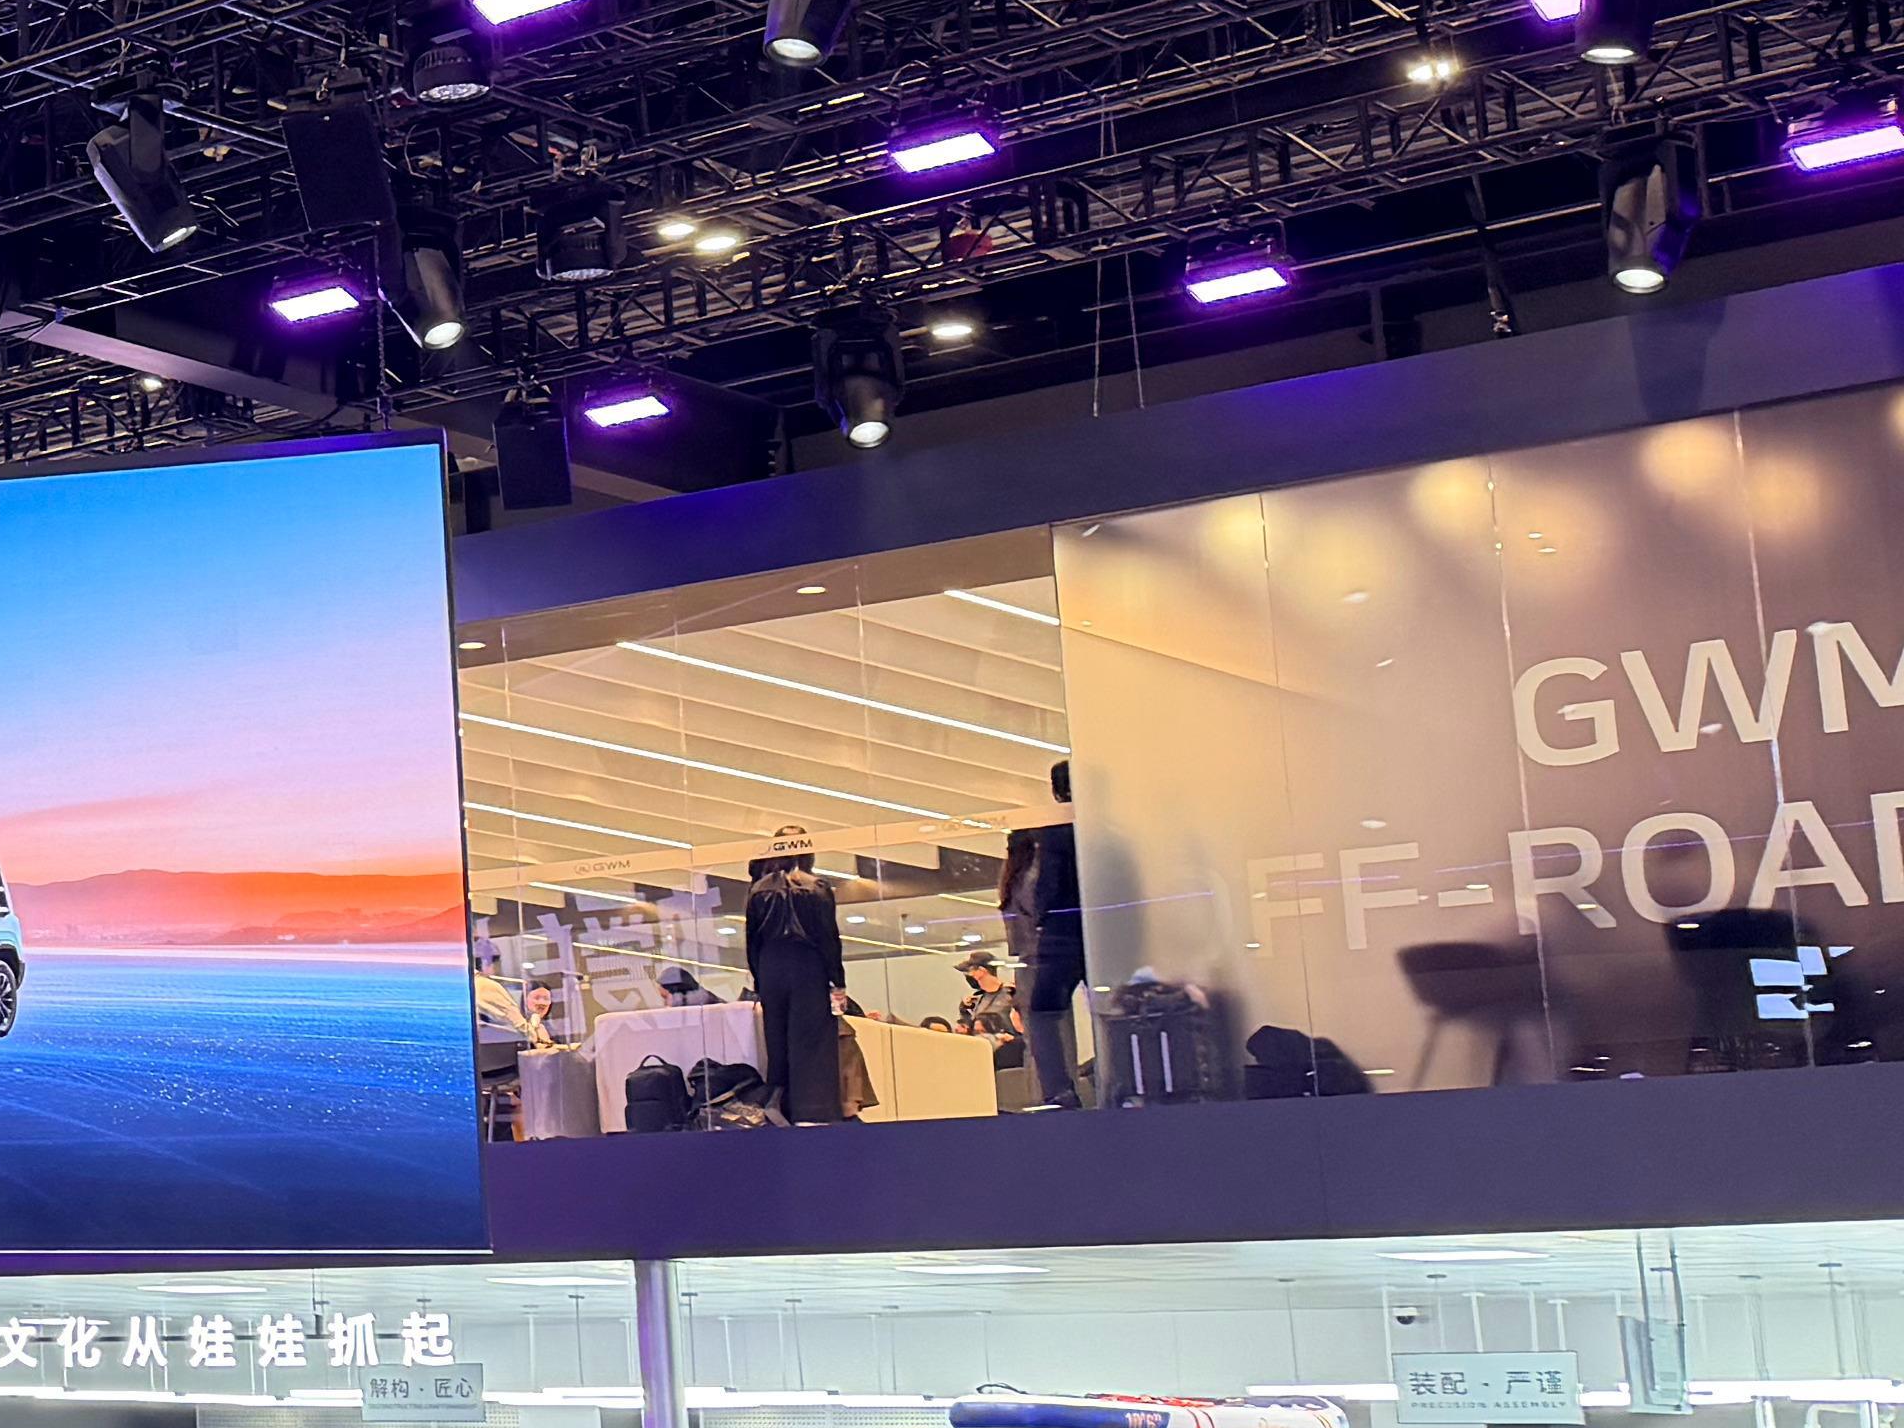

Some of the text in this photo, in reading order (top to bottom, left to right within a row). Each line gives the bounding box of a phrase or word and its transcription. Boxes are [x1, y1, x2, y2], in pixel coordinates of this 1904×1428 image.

[1513, 621, 1904, 767] GWM
[772, 838, 813, 853] GWM
[593, 859, 631, 872] GWM
[1210, 791, 1904, 959] FF-ROA
[1410, 1401, 1567, 1409] PRECISION ASSEMBLY
